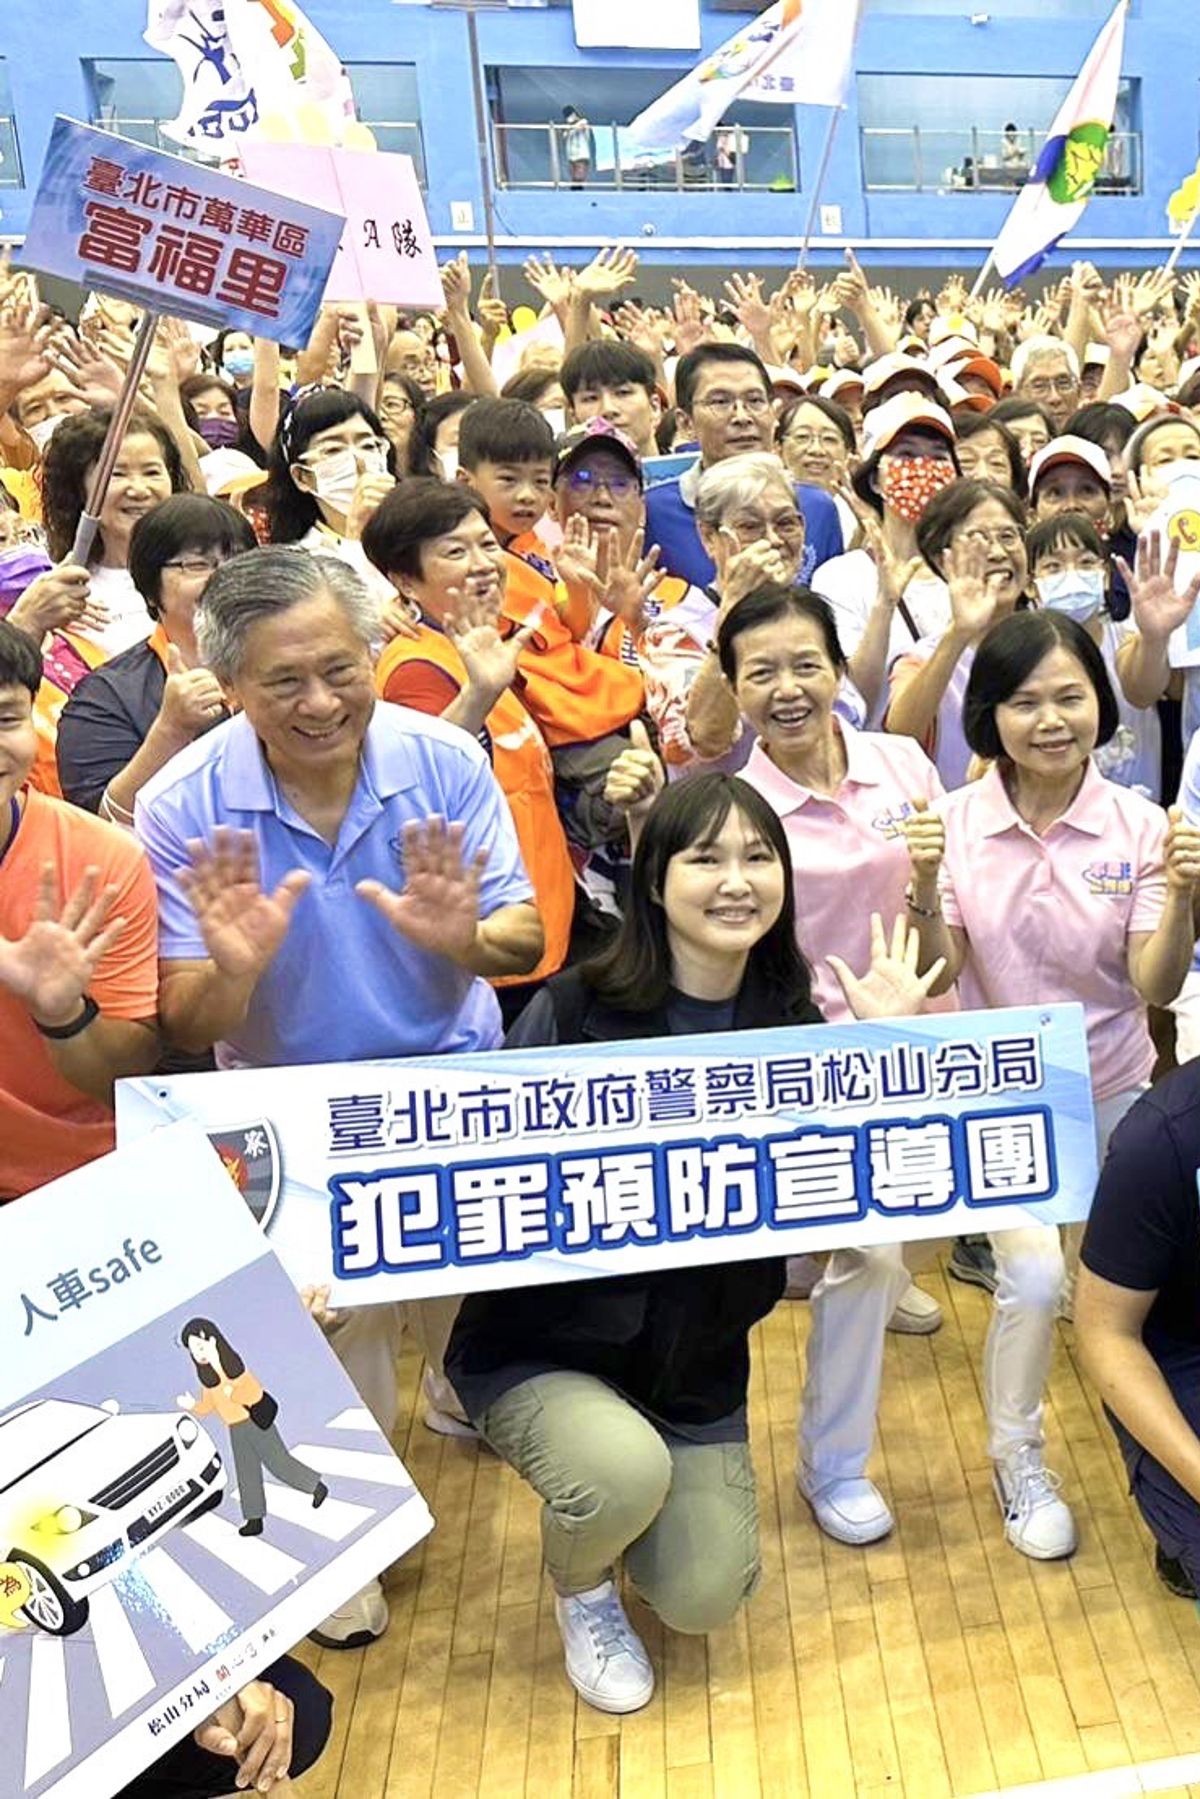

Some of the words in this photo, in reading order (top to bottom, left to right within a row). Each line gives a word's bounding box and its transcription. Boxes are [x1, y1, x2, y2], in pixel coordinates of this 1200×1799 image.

[77, 200, 288, 318] 富福里
[84, 156, 310, 259] 臺北市萬華區
[327, 1033, 1042, 1151] 臺北市政府警察局松山分局
[334, 1107, 1054, 1276] 犯罪預防宣導團
